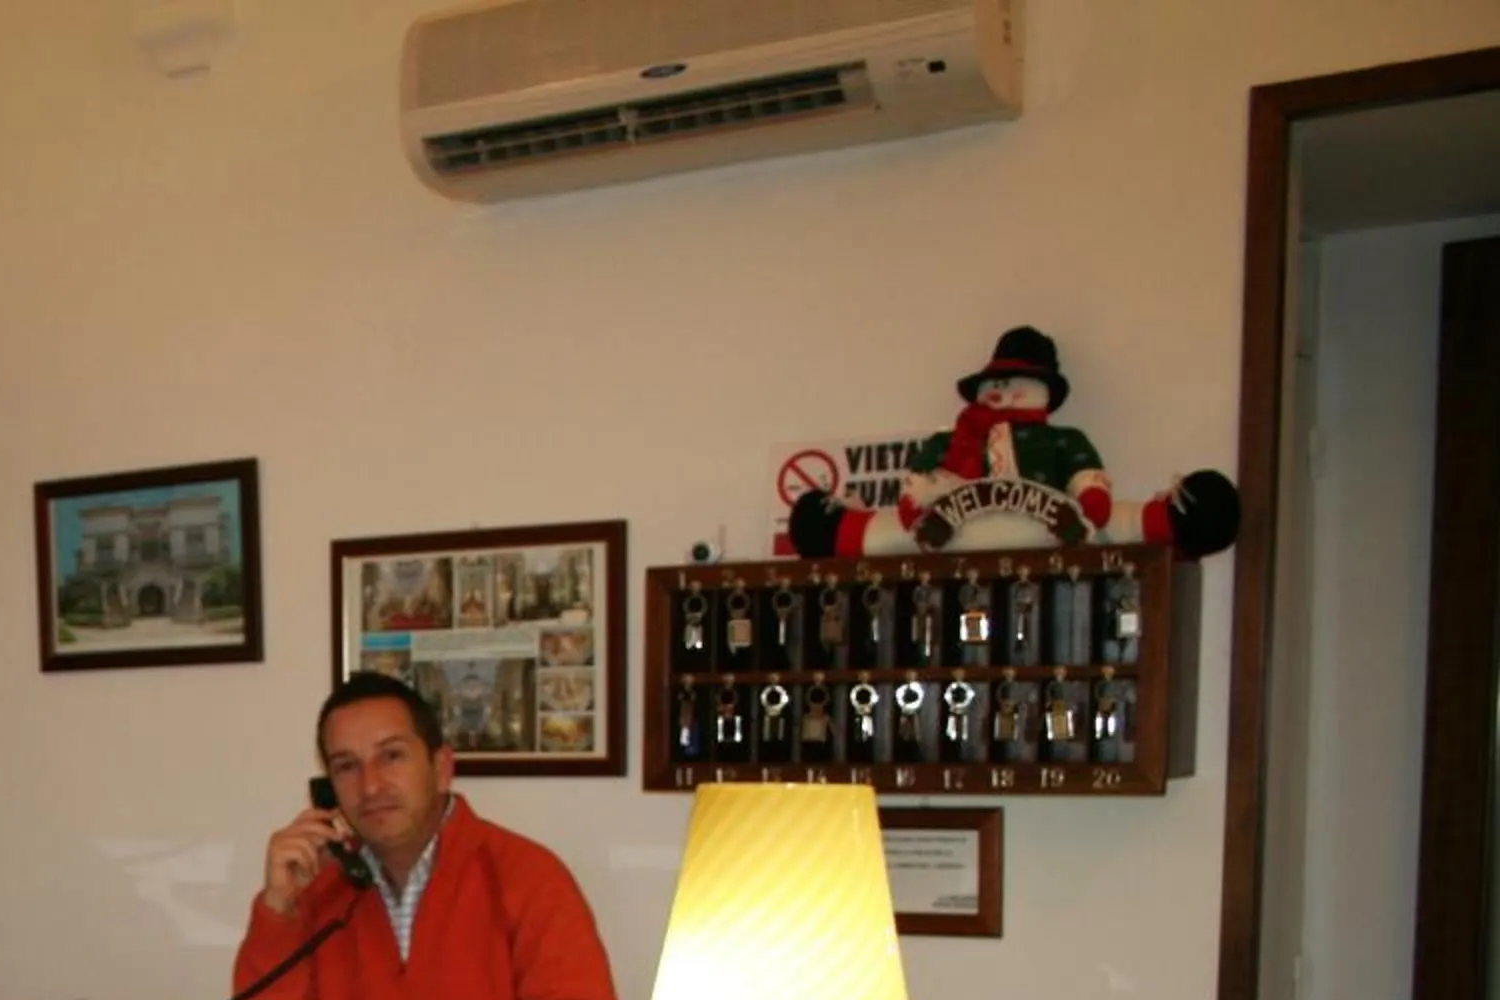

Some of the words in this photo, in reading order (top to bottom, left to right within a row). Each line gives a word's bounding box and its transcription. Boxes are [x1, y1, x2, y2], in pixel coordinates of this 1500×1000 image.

[844, 441, 920, 474] VIETA
[844, 478, 901, 507] FUM
[934, 480, 1059, 527] WELCOME
[998, 555, 1014, 578] 8
[1047, 551, 1063, 575] 9
[1100, 548, 1124, 573] 10
[990, 767, 1015, 789] 18
[1040, 766, 1065, 789] 19
[1091, 766, 1123, 789] 20
